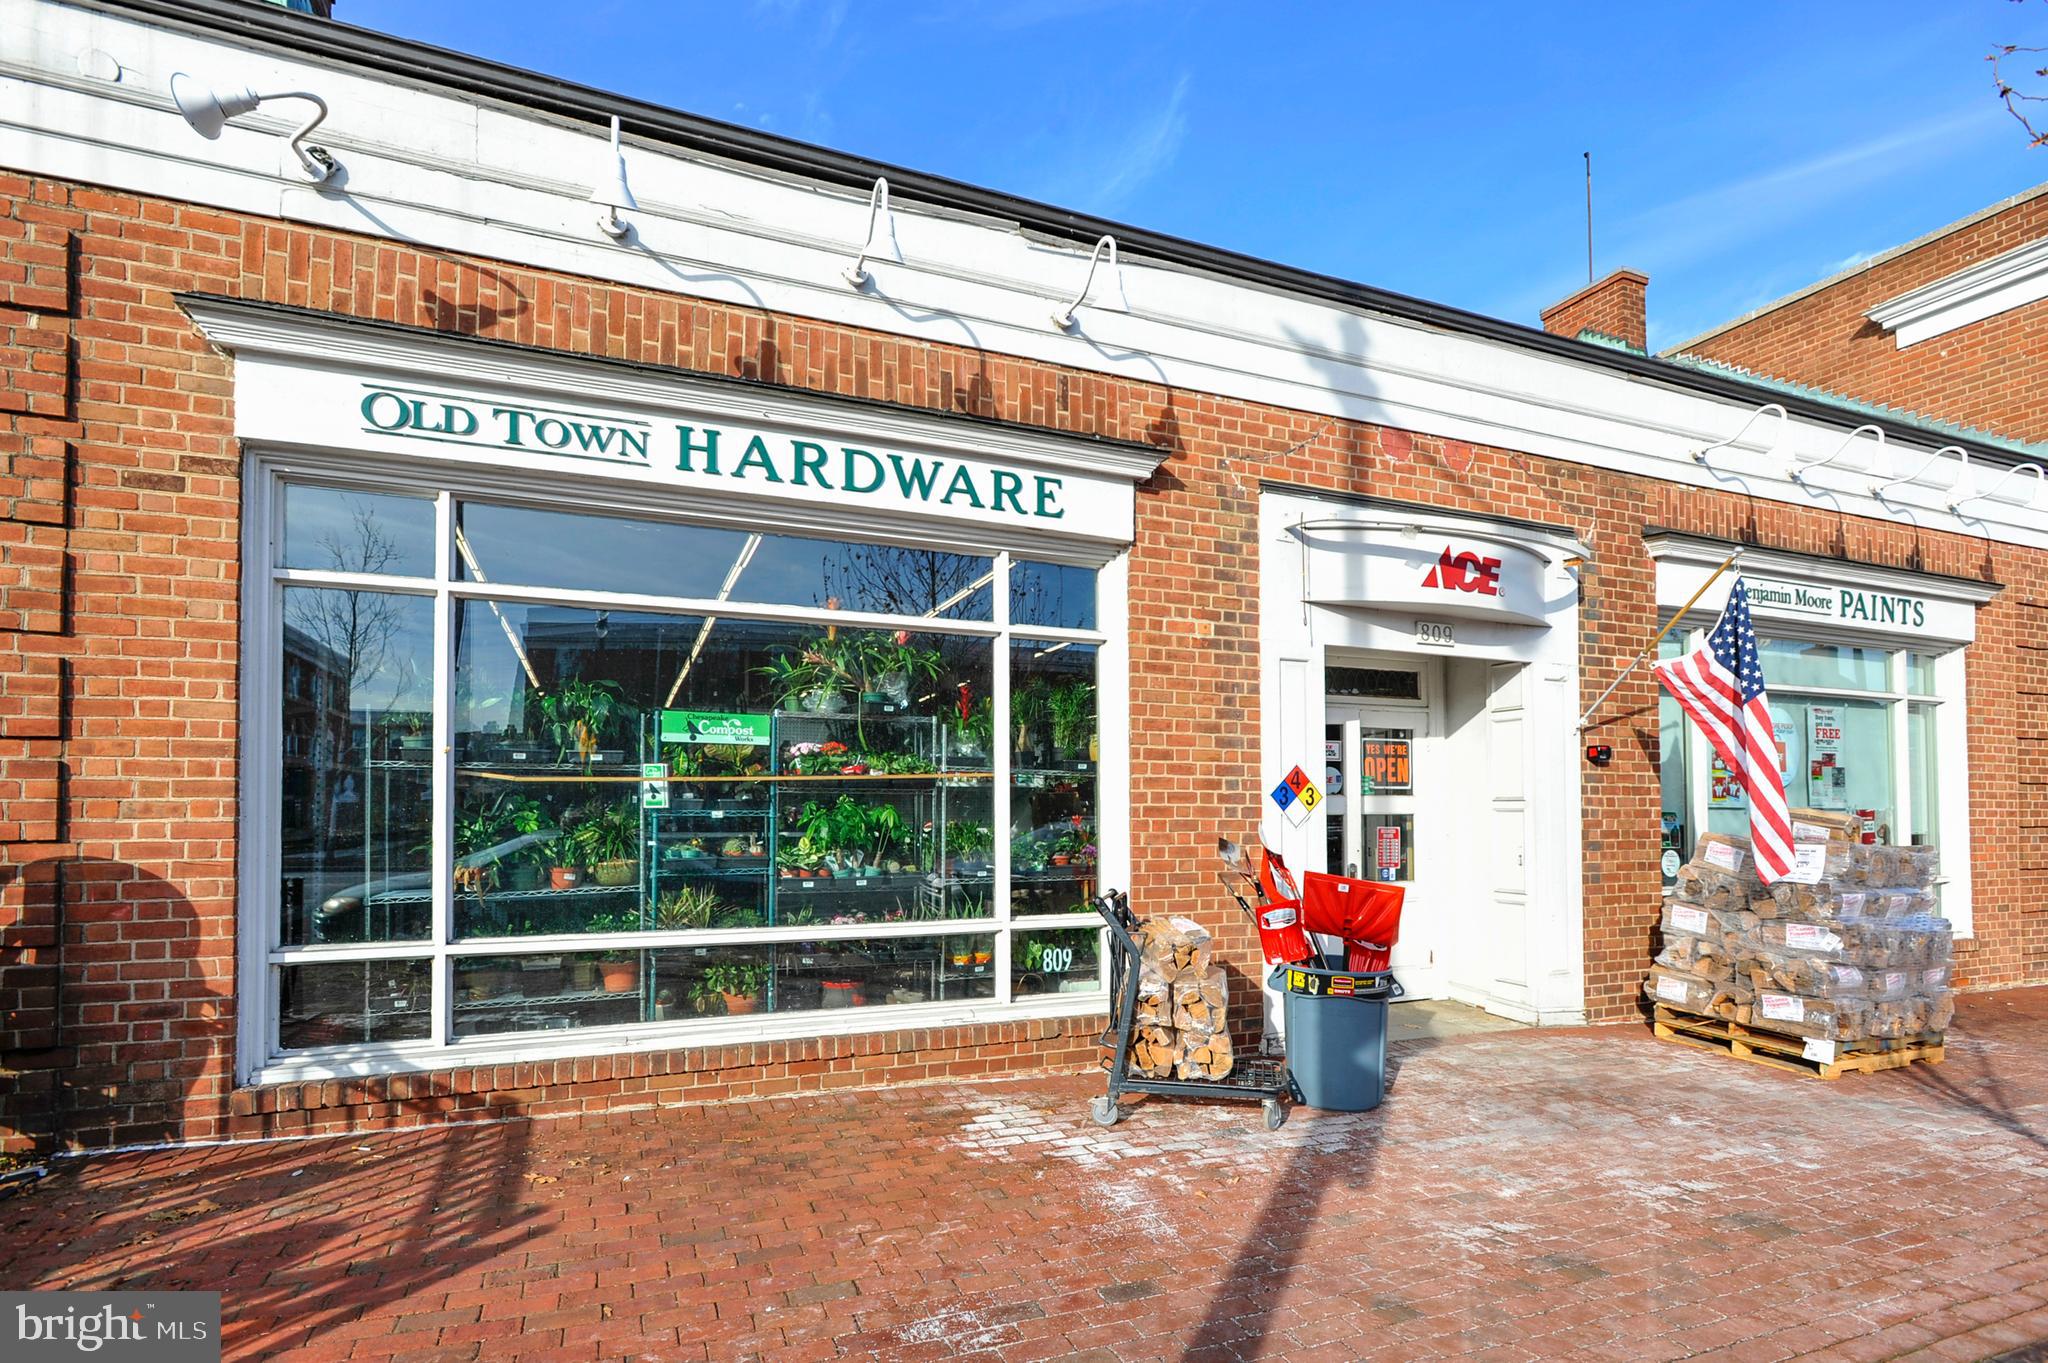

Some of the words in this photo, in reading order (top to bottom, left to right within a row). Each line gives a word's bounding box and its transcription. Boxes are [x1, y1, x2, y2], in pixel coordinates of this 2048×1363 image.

[361, 391, 479, 436] OLD
[492, 408, 652, 460] TOWN
[675, 425, 1067, 520] HARDWARE
[1421, 544, 1502, 597] ACE
[1745, 583, 1792, 604] enjamin
[1794, 588, 1833, 610] Moore
[1839, 589, 1925, 628] PAINTS
[1420, 623, 1454, 643] 809
[698, 718, 754, 737] Compost
[1815, 728, 1841, 739] FREE
[1366, 743, 1381, 755] YES
[1383, 744, 1408, 756] WE'RE
[1290, 771, 1301, 789] 4
[1364, 757, 1409, 783] OPEN
[1279, 786, 1289, 806] 3
[1305, 787, 1315, 806] 3
[1042, 948, 1073, 973] 809
